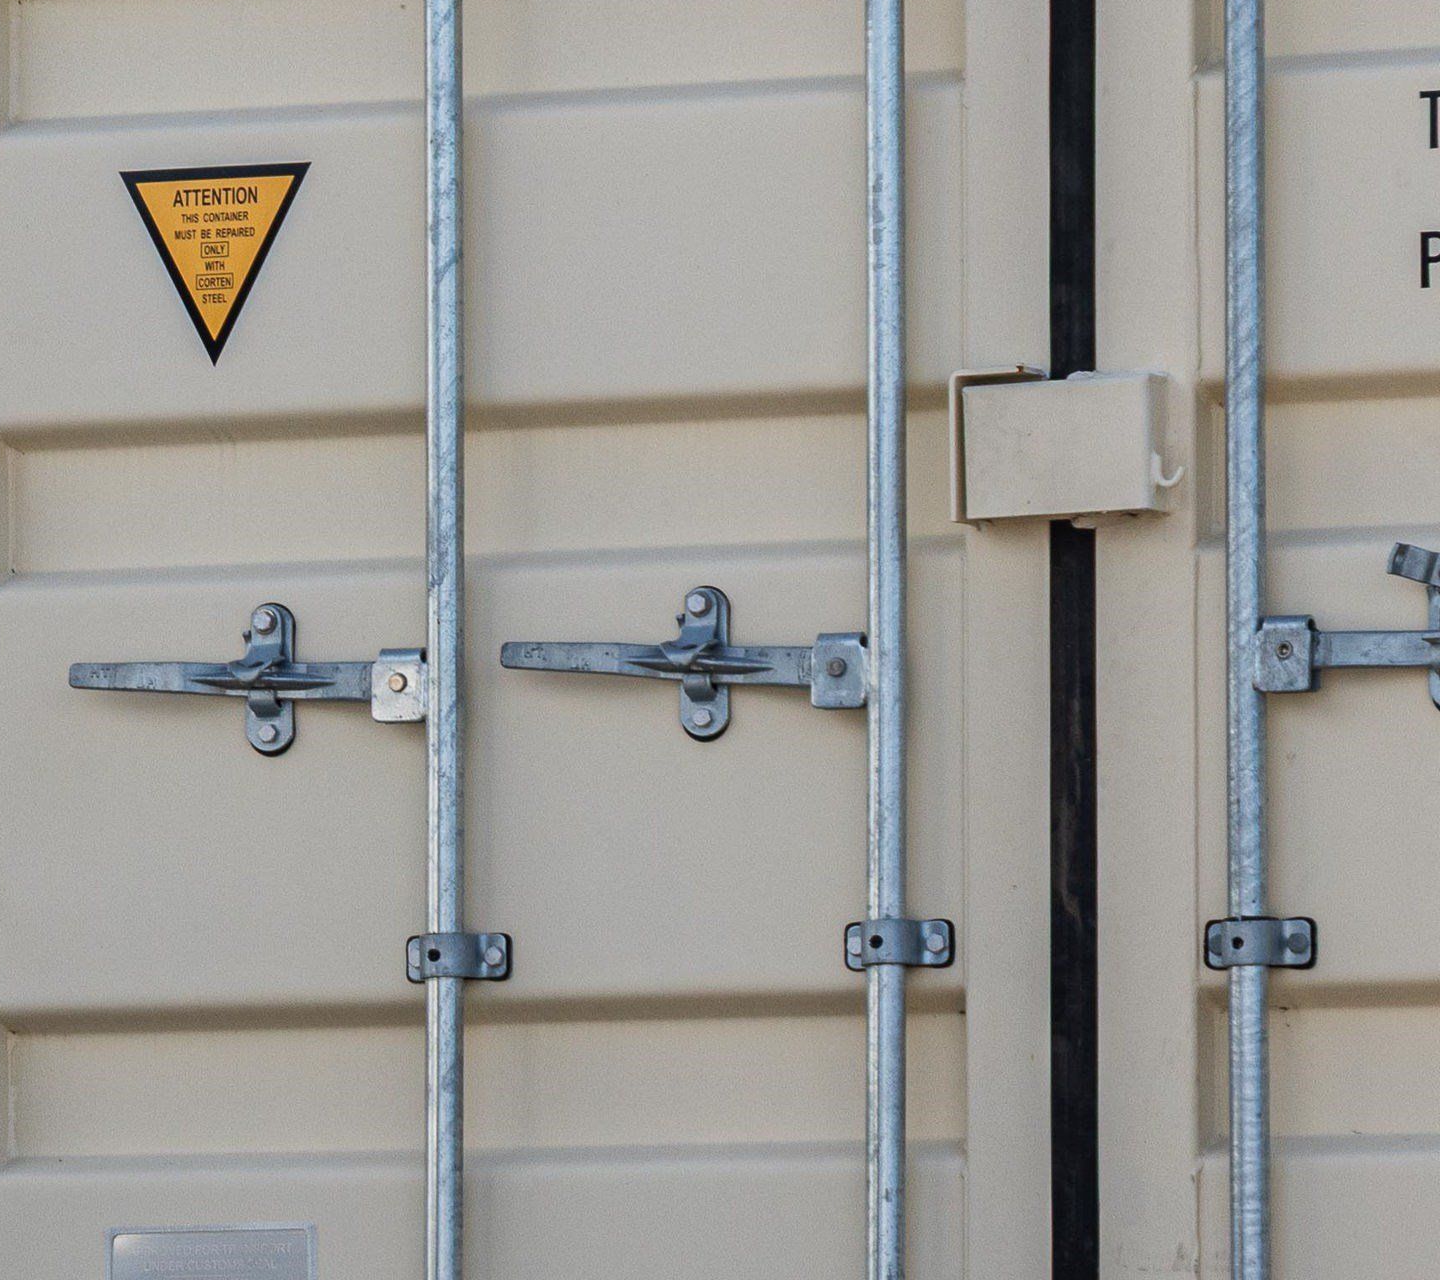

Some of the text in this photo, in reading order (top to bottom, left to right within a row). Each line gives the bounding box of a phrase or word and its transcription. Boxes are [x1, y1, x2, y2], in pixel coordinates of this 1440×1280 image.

[172, 186, 258, 208] ATTENTION
[181, 211, 249, 223] THIS CONTAINER
[174, 227, 256, 240] MUST BE REPAIRED
[204, 245, 225, 255] ONLY
[205, 261, 225, 271] WITH
[198, 277, 232, 288] CORTEN
[202, 293, 227, 304] STEEL
